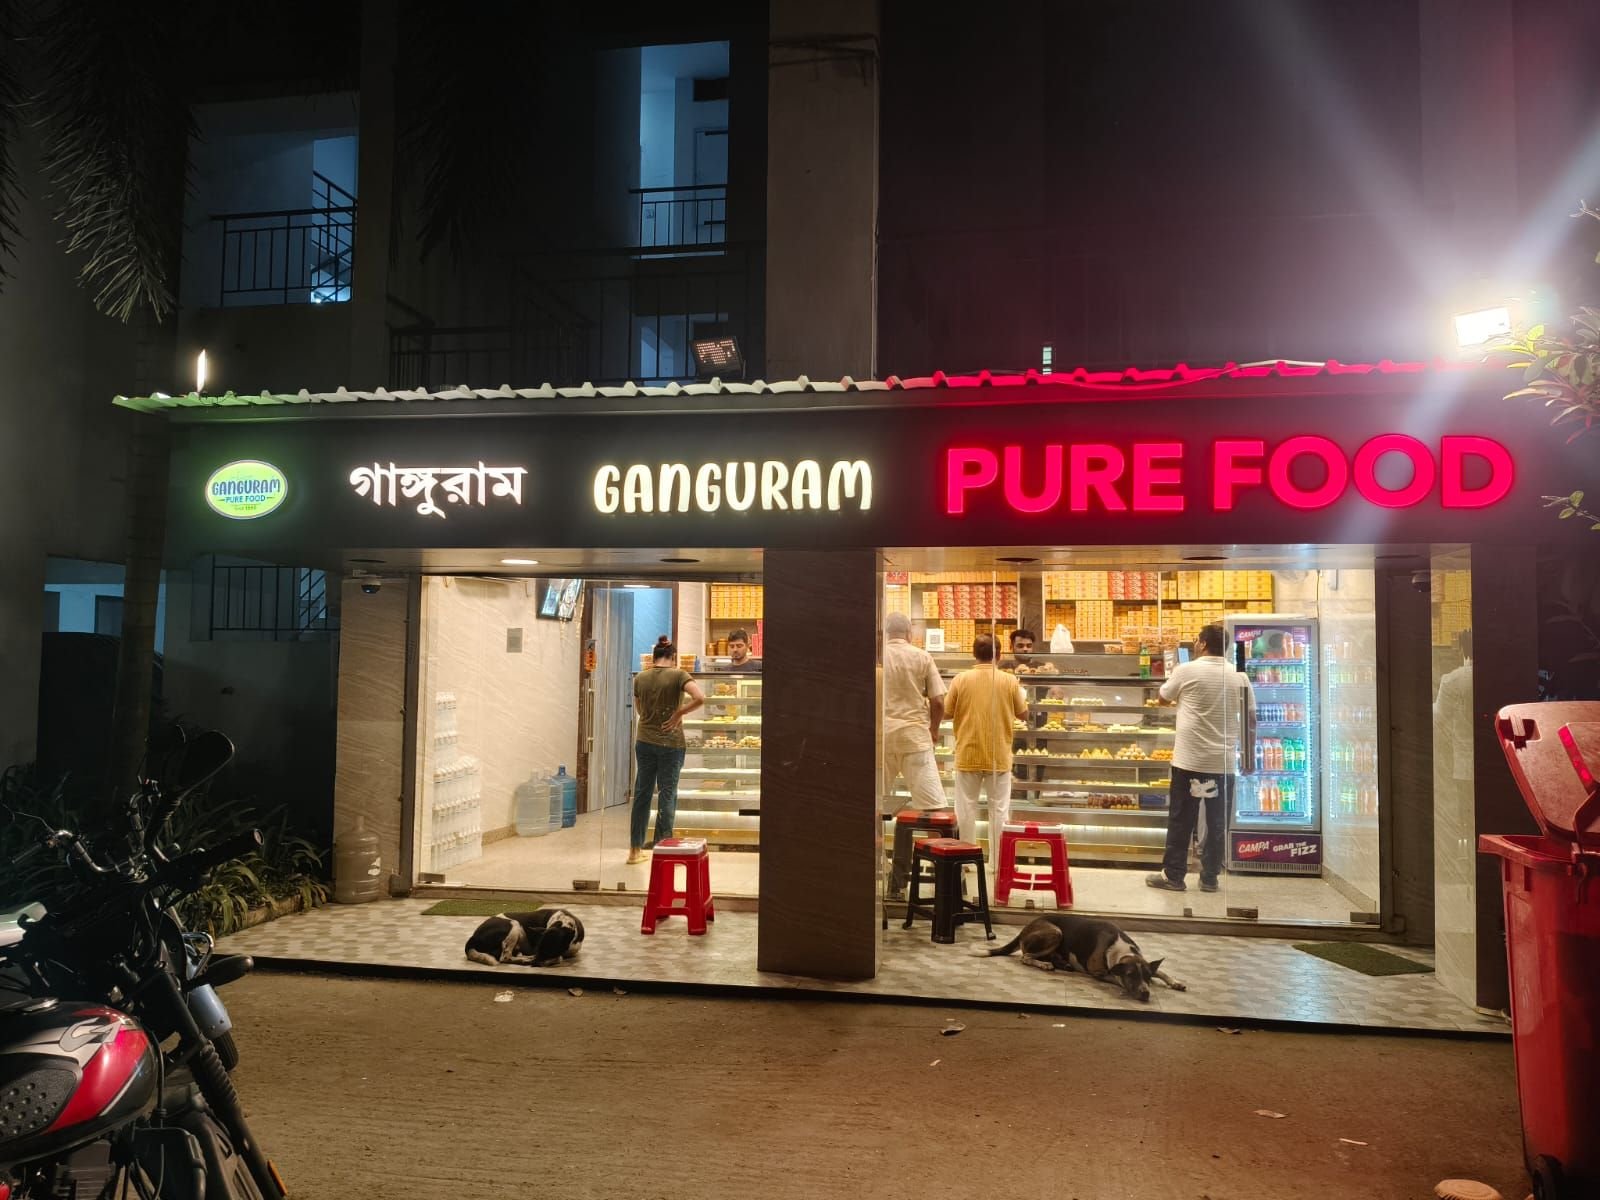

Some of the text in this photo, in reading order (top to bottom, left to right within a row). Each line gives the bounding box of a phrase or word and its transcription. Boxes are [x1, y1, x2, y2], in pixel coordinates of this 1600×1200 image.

[594, 433, 1515, 515] GANGURAM PURE FOOD
[212, 479, 280, 495] GANGURAM
[350, 460, 528, 519] গাঙ্গুরাম
[1238, 841, 1270, 853] CAMPA
[1273, 843, 1294, 852] GRAB
[1290, 845, 1317, 857] FIZZ
